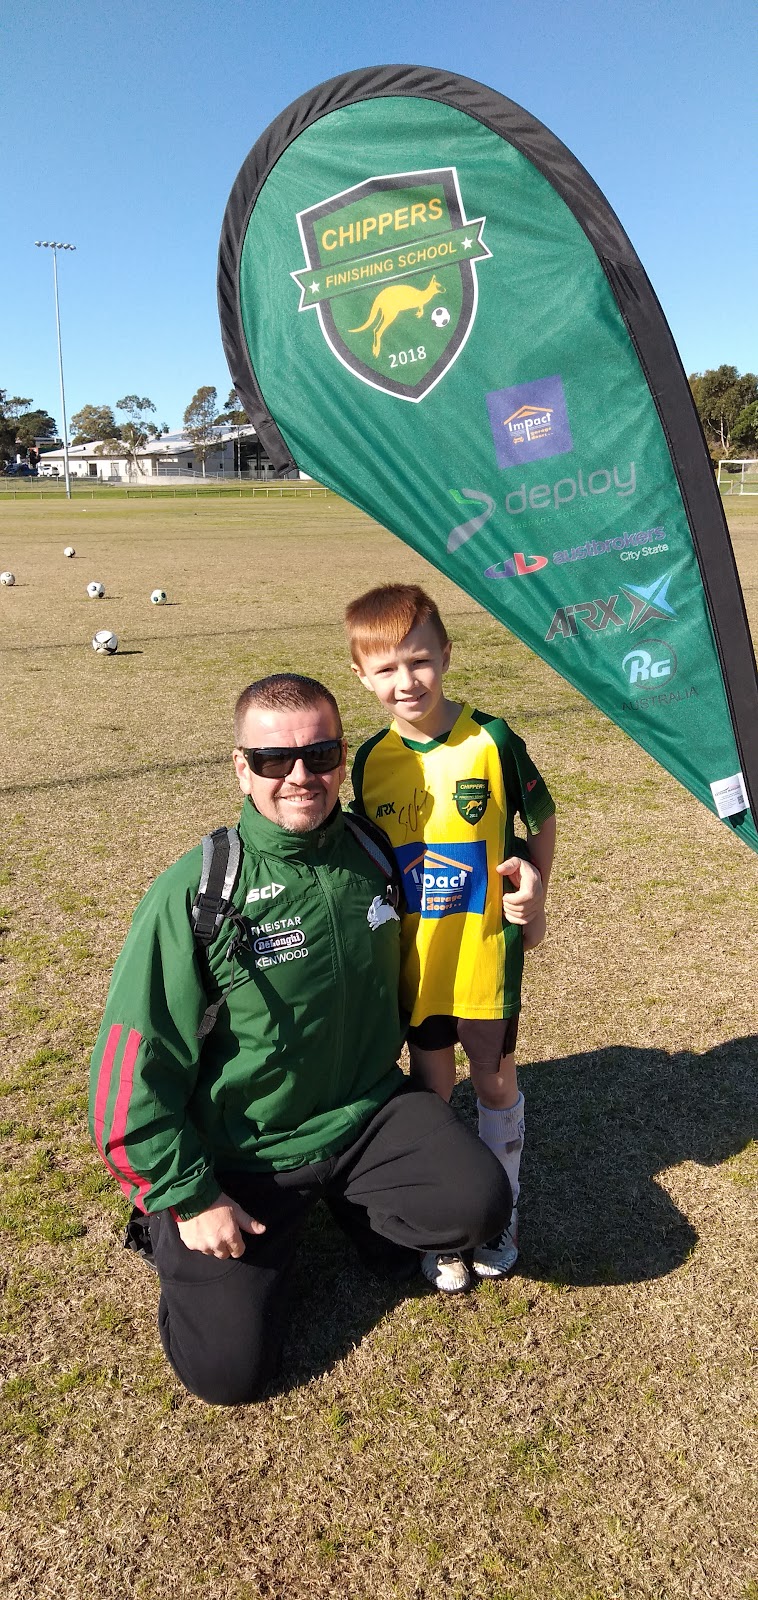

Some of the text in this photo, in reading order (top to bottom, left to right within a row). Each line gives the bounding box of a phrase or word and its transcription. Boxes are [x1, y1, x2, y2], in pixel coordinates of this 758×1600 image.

[322, 198, 443, 251] CHIPPERS
[325, 241, 458, 289] FINISHING SCHOOL
[388, 345, 427, 369] 2018
[508, 412, 551, 442] Impact
[505, 461, 637, 515] deploy
[552, 526, 667, 565] austbrokers
[620, 543, 669, 563] City State
[622, 649, 671, 684] RG
[621, 686, 699, 711] AUSTRALIA
[250, 916, 302, 937] THE STAR
[255, 947, 309, 969] KENWOOD
